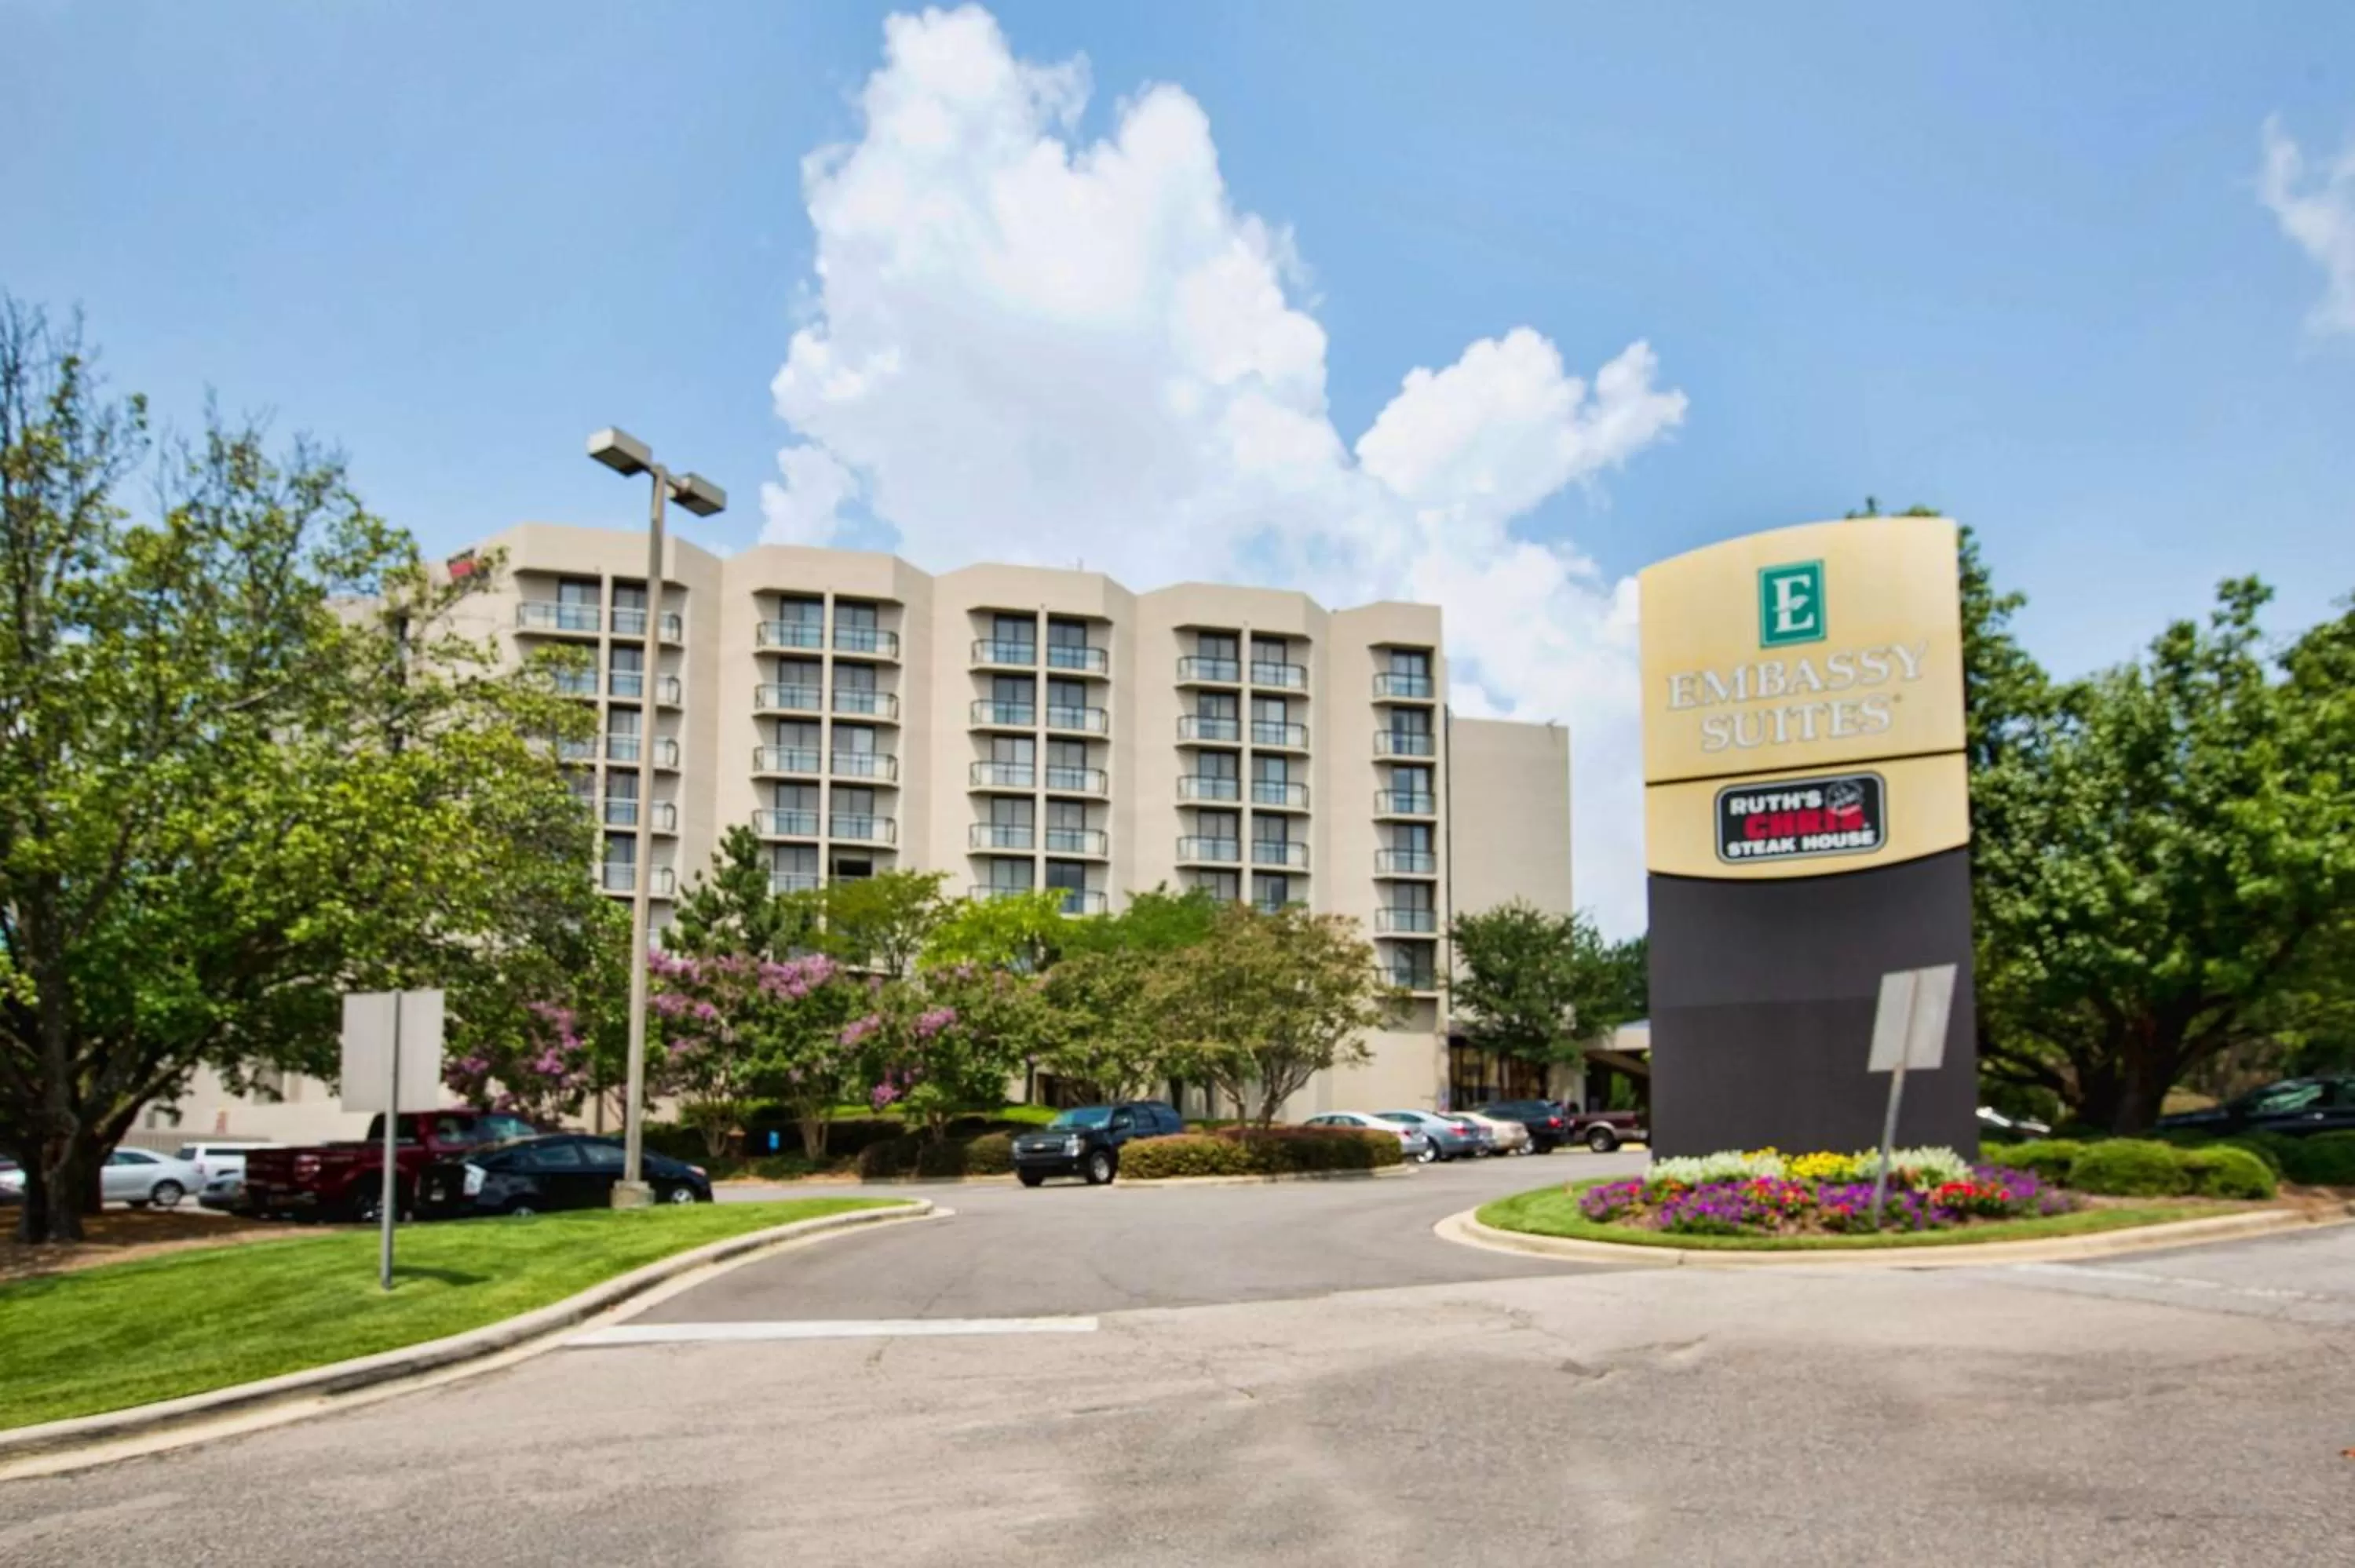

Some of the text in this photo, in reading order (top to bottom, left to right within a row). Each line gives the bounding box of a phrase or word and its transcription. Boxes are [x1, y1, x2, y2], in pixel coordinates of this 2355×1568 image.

[1773, 574, 1814, 633] E
[1667, 642, 1927, 710] EMBASSY
[1701, 695, 1891, 753] SUITES
[1729, 789, 1821, 815] RUTH'S
[1743, 806, 1865, 841] CHRIS
[1727, 830, 1875, 857] STEAK HOUSE
